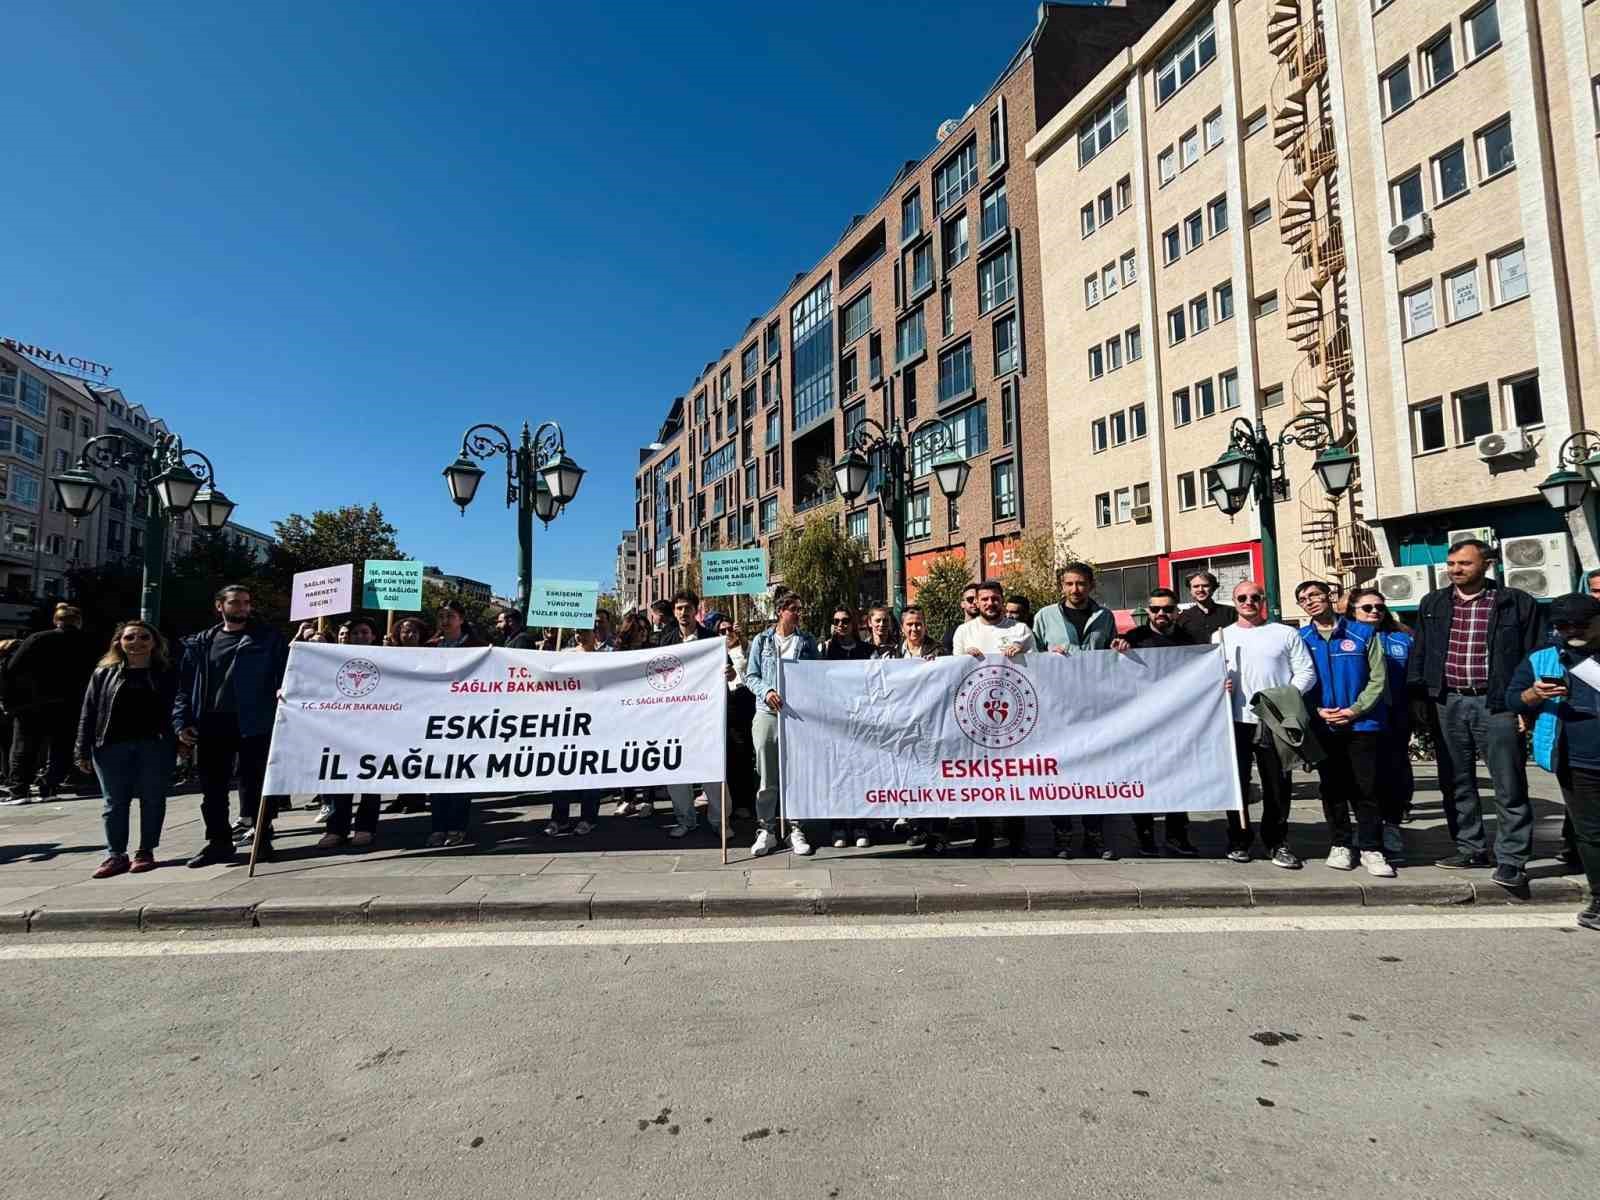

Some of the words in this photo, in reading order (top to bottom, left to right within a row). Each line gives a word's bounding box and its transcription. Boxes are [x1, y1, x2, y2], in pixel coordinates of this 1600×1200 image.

[0, 336, 66, 365] ENNA
[68, 356, 112, 377] CITY
[508, 667, 532, 679] T.C.
[450, 679, 503, 694] SAĞLIK
[506, 678, 582, 693] BAKANLIĞI
[301, 702, 317, 711] T.C.
[319, 701, 352, 712] SAĞLIK
[352, 702, 403, 712] BAKANLIĞI
[620, 697, 634, 707] T.C.
[635, 695, 664, 706] SAĞLIK
[665, 693, 709, 705] BAKANLIĞI
[424, 706, 593, 743] ESKİŞEHİR
[318, 747, 349, 781] İL
[356, 748, 480, 781] SAĞLIK
[485, 738, 684, 779] MÜDÜRLÜĞÜ
[941, 754, 1060, 782] ESKİŞEHİR
[865, 787, 934, 806] GENÇLİK
[934, 788, 958, 803] VE
[960, 787, 1006, 803] SPOR
[1009, 783, 1025, 802] İL
[1030, 781, 1146, 801] MÜDÜRLÜĞÜ
